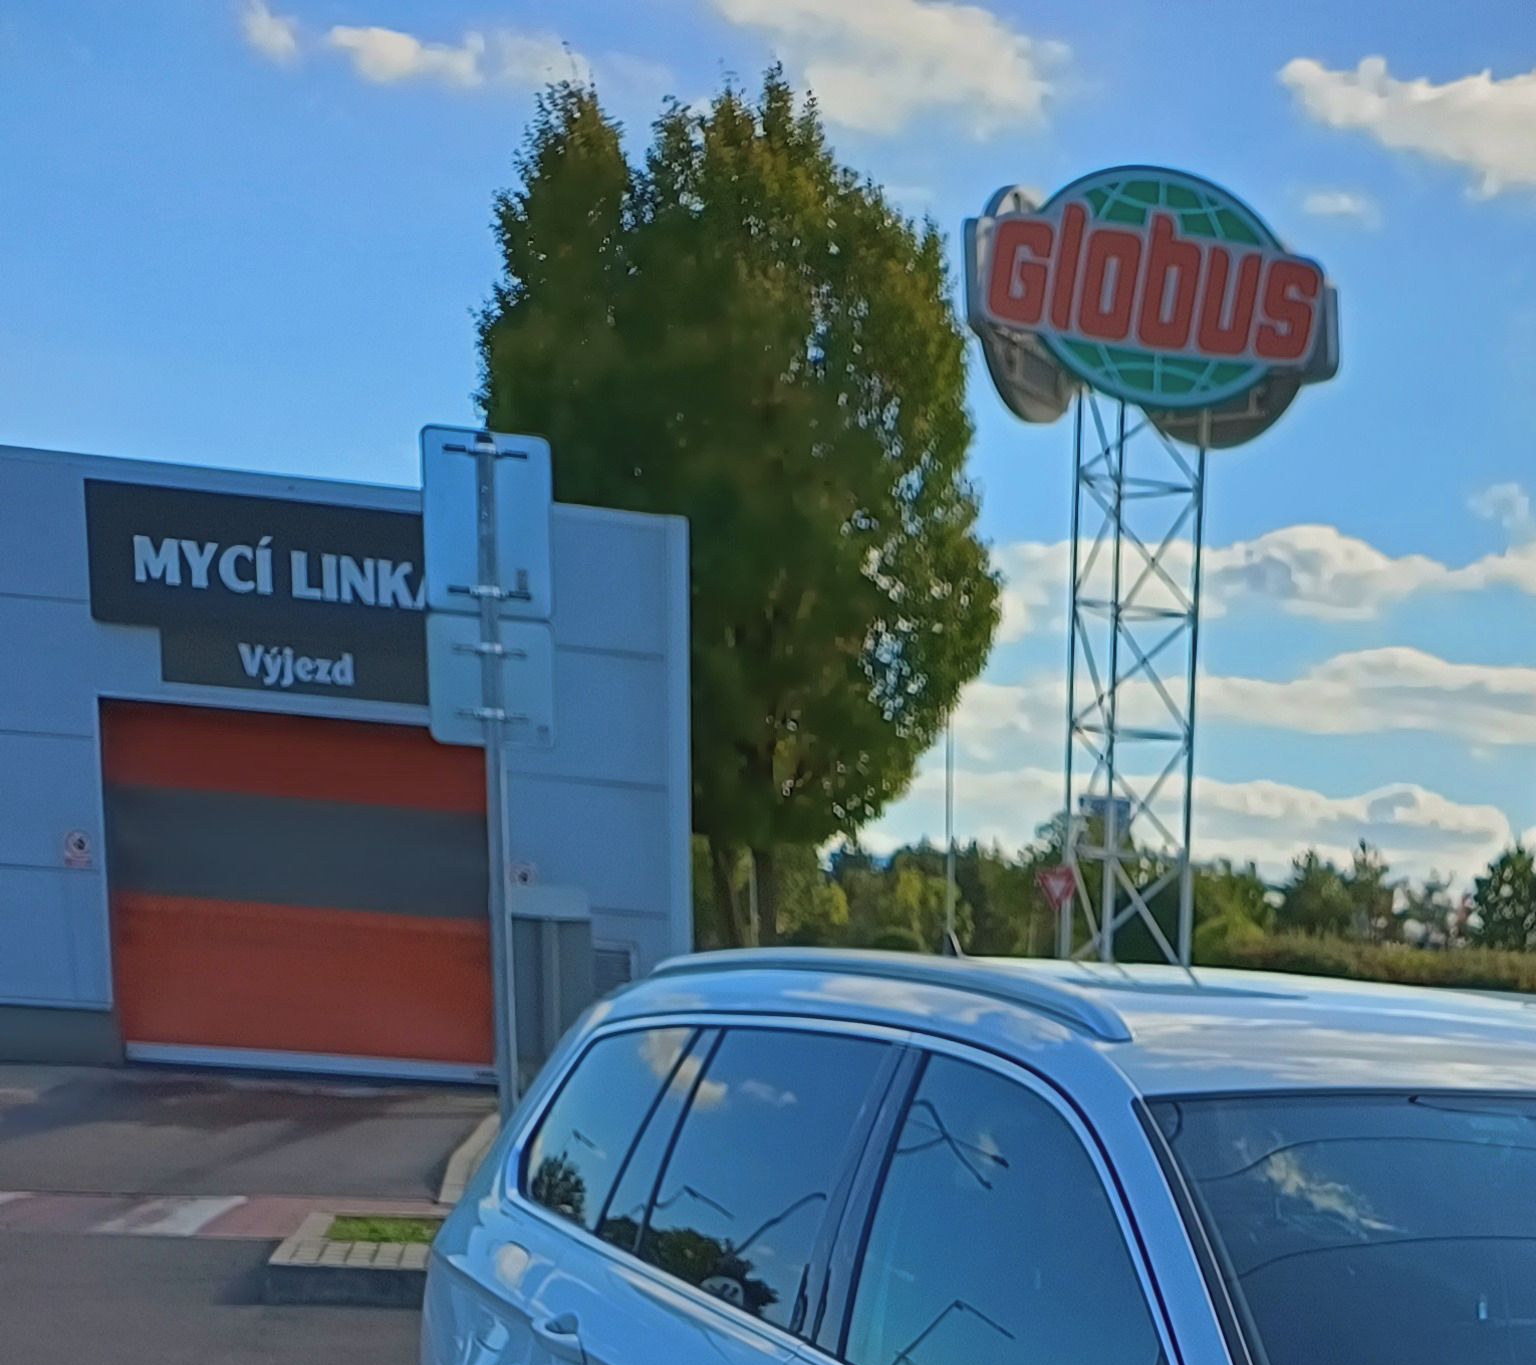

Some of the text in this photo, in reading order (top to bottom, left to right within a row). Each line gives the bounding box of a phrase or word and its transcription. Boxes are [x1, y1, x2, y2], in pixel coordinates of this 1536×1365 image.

[987, 202, 1320, 360] Globus
[132, 535, 273, 595] MYCÍ
[238, 642, 355, 687] Výjezd
